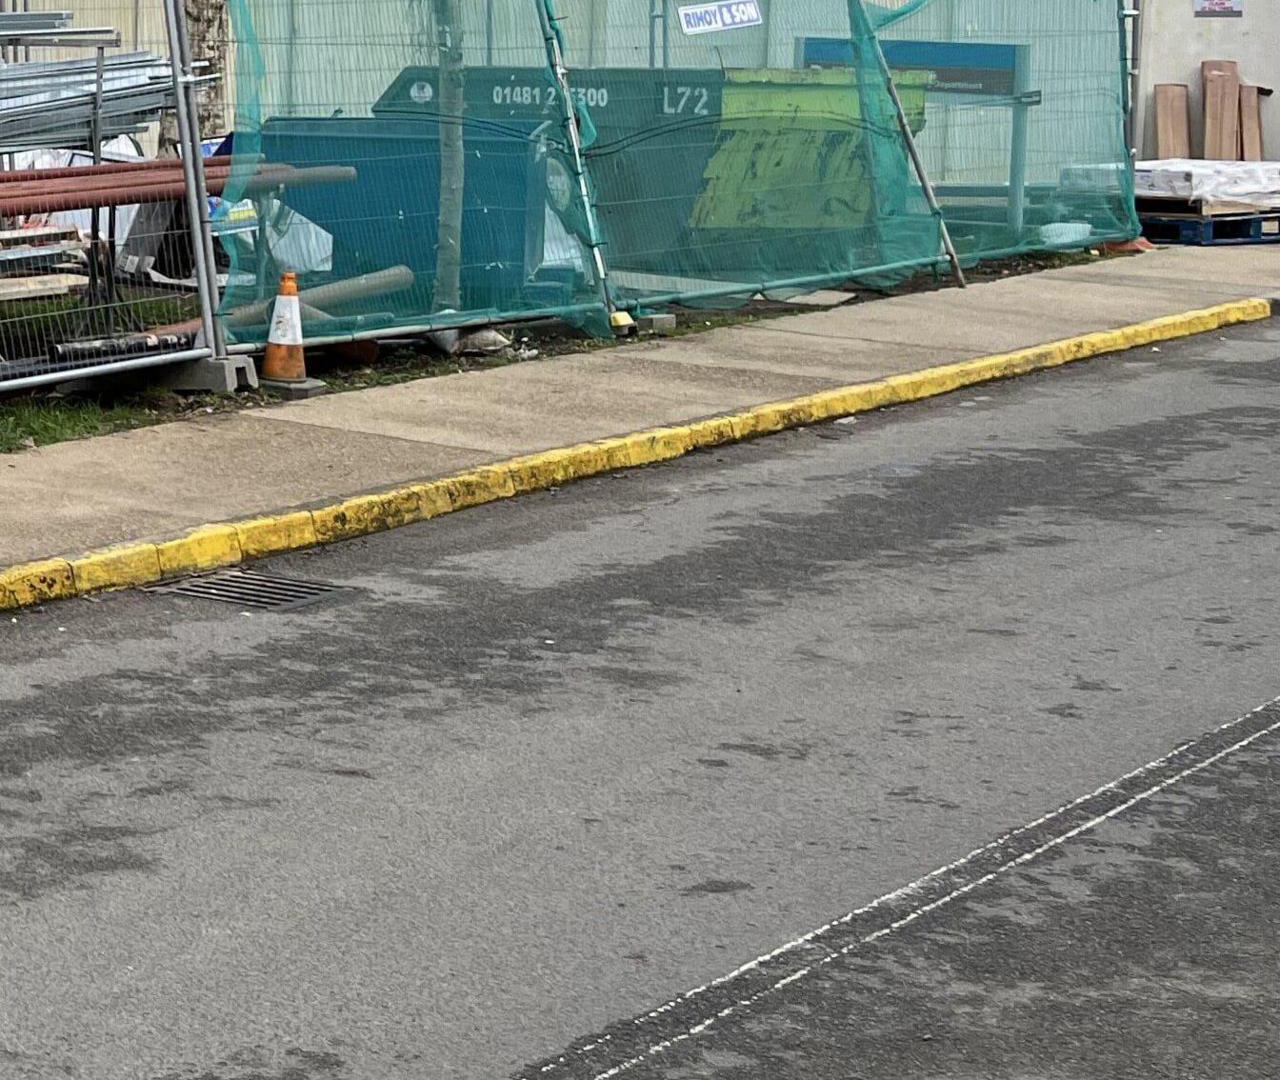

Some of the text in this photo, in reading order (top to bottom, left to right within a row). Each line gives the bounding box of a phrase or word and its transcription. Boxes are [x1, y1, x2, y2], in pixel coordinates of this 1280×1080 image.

[683, 2, 758, 29] RIHOY & SON
[493, 86, 540, 105] 01481
[663, 86, 709, 115] L72
